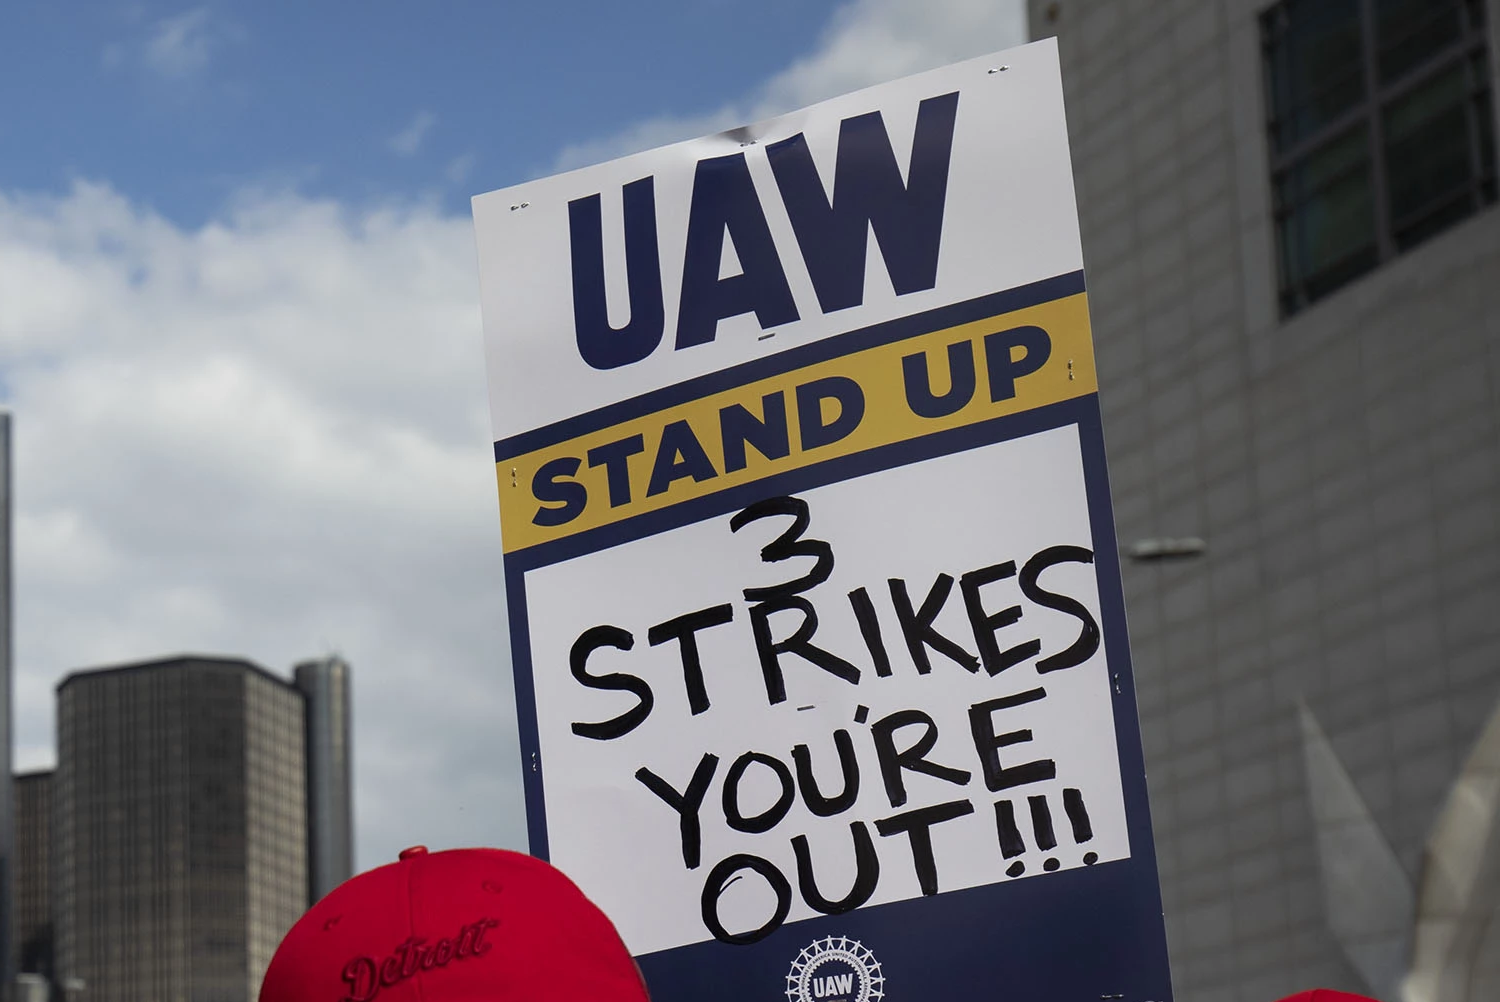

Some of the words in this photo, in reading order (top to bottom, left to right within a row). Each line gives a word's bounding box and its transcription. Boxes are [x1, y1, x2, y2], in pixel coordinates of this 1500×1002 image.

[567, 90, 960, 370] UAW
[531, 375, 866, 527] STAND
[900, 325, 1052, 418] UP
[569, 544, 1101, 740] STRIKES
[730, 496, 835, 602] 3
[635, 687, 1057, 870] YOU'RE
[813, 973, 853, 998] UAW
